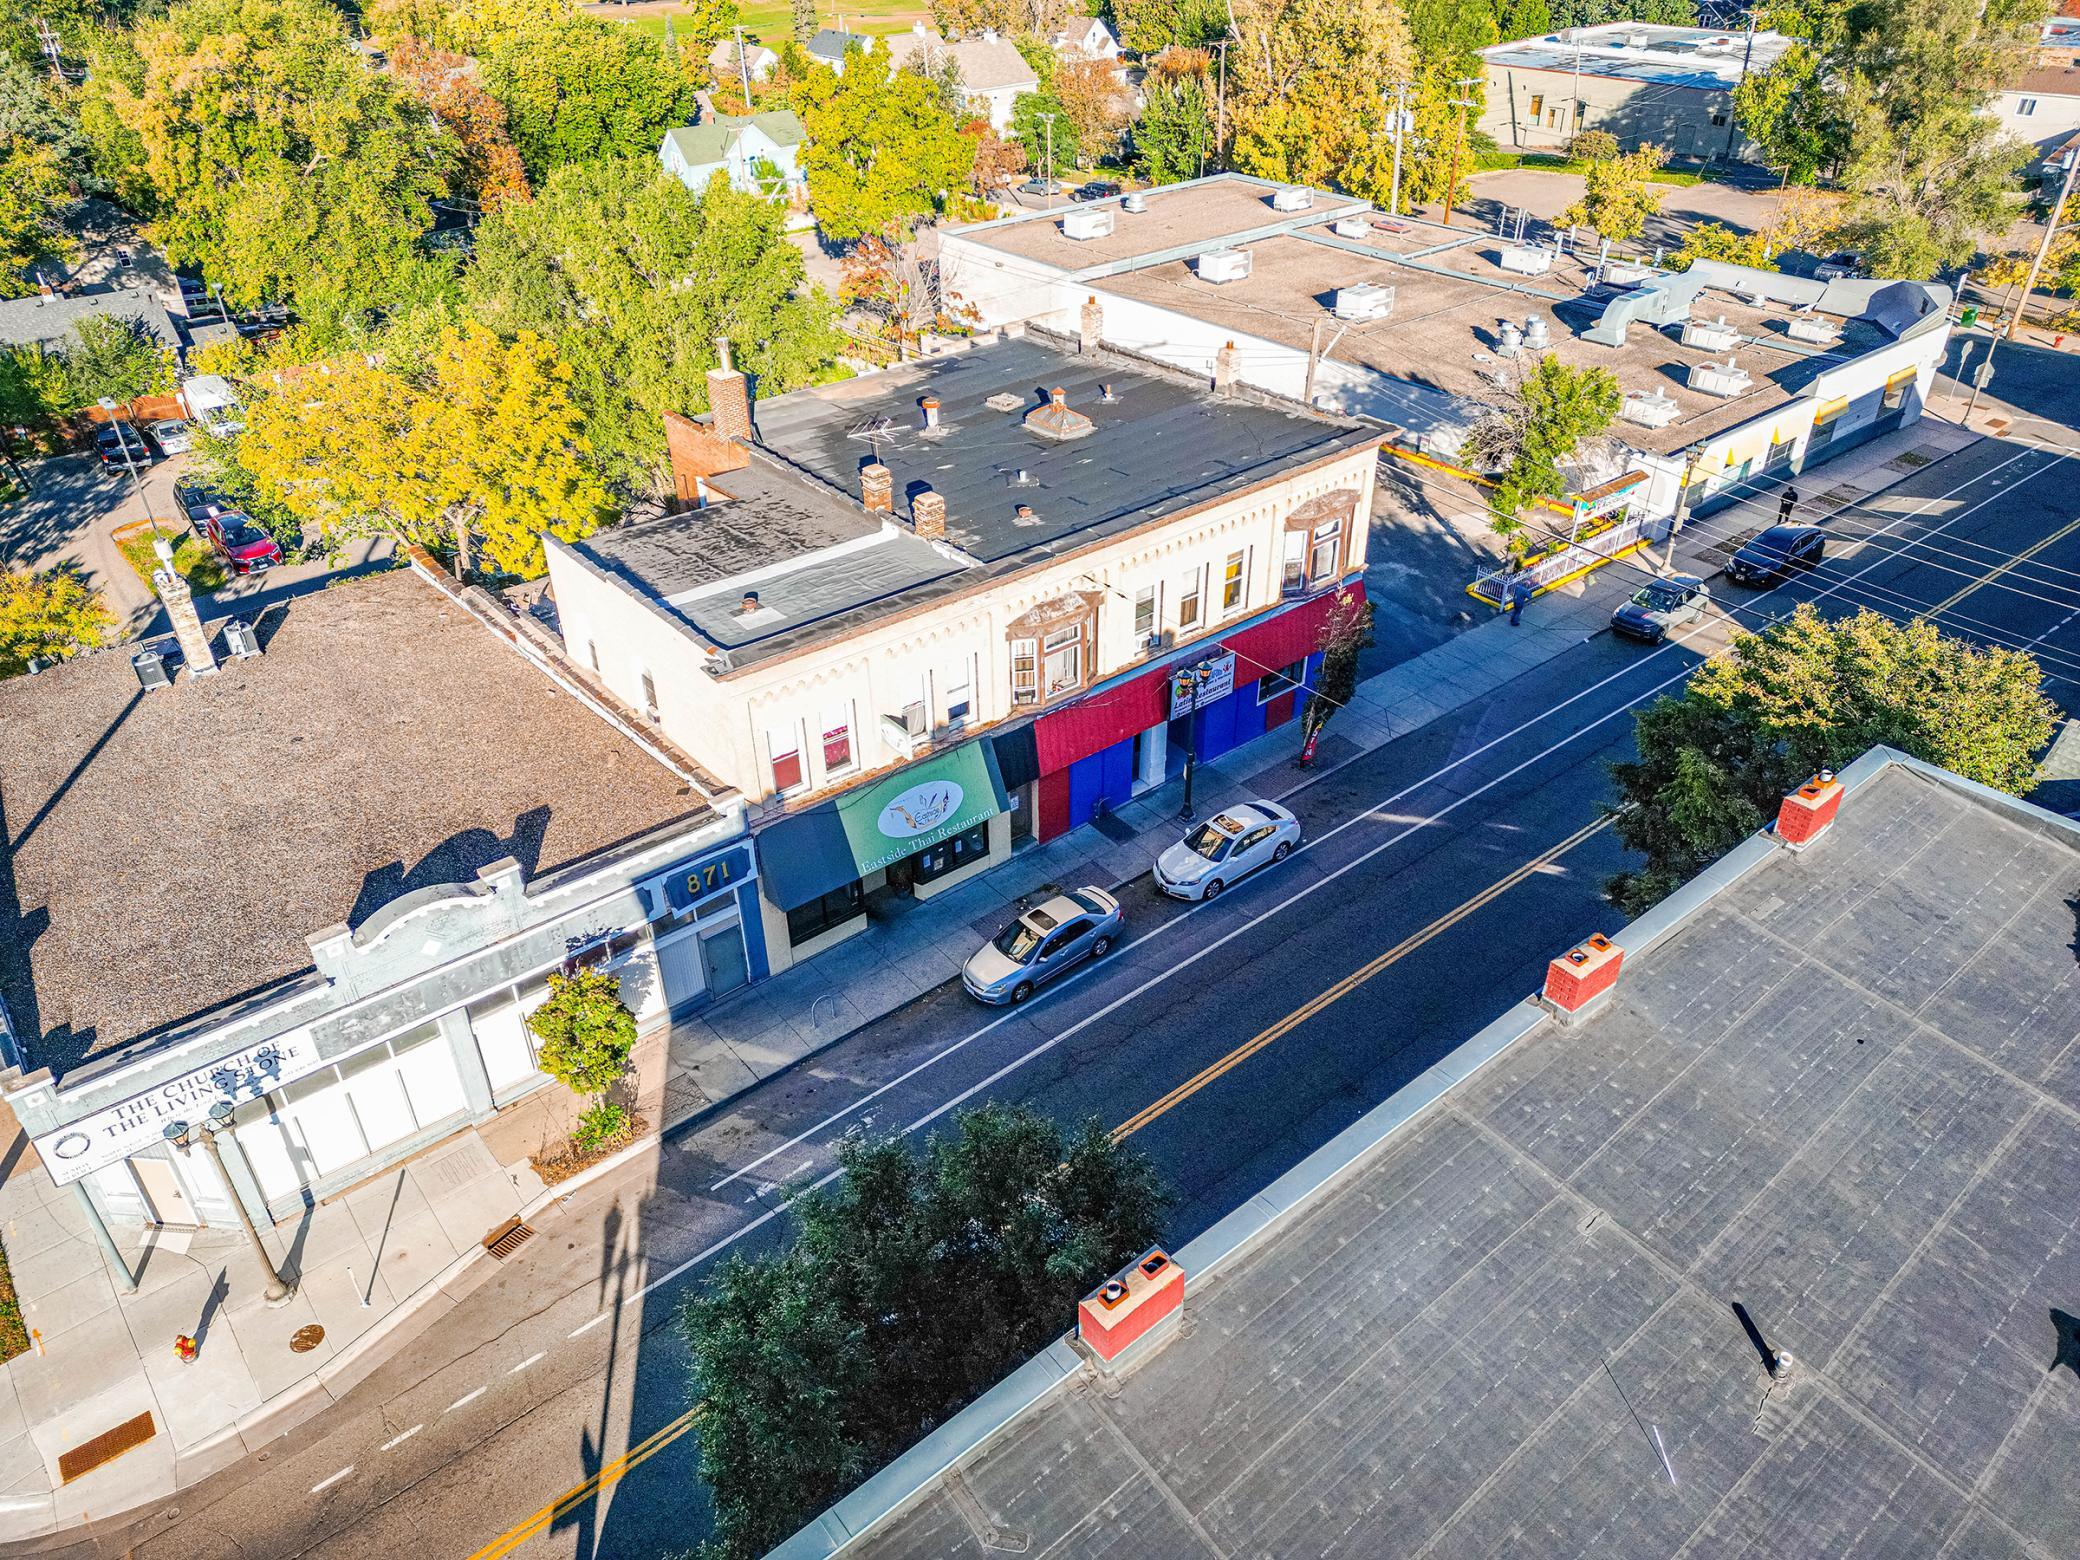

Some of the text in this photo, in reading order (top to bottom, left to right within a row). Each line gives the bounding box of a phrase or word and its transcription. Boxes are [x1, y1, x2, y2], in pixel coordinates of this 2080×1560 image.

[687, 861, 729, 893] 871
[861, 808, 994, 874] Eastside Thai Restaurant
[102, 1112, 150, 1137] THE
[154, 1077, 228, 1117] LIVING
[233, 1046, 300, 1082] STONE
[111, 1040, 280, 1120] THE CHURCH OF
